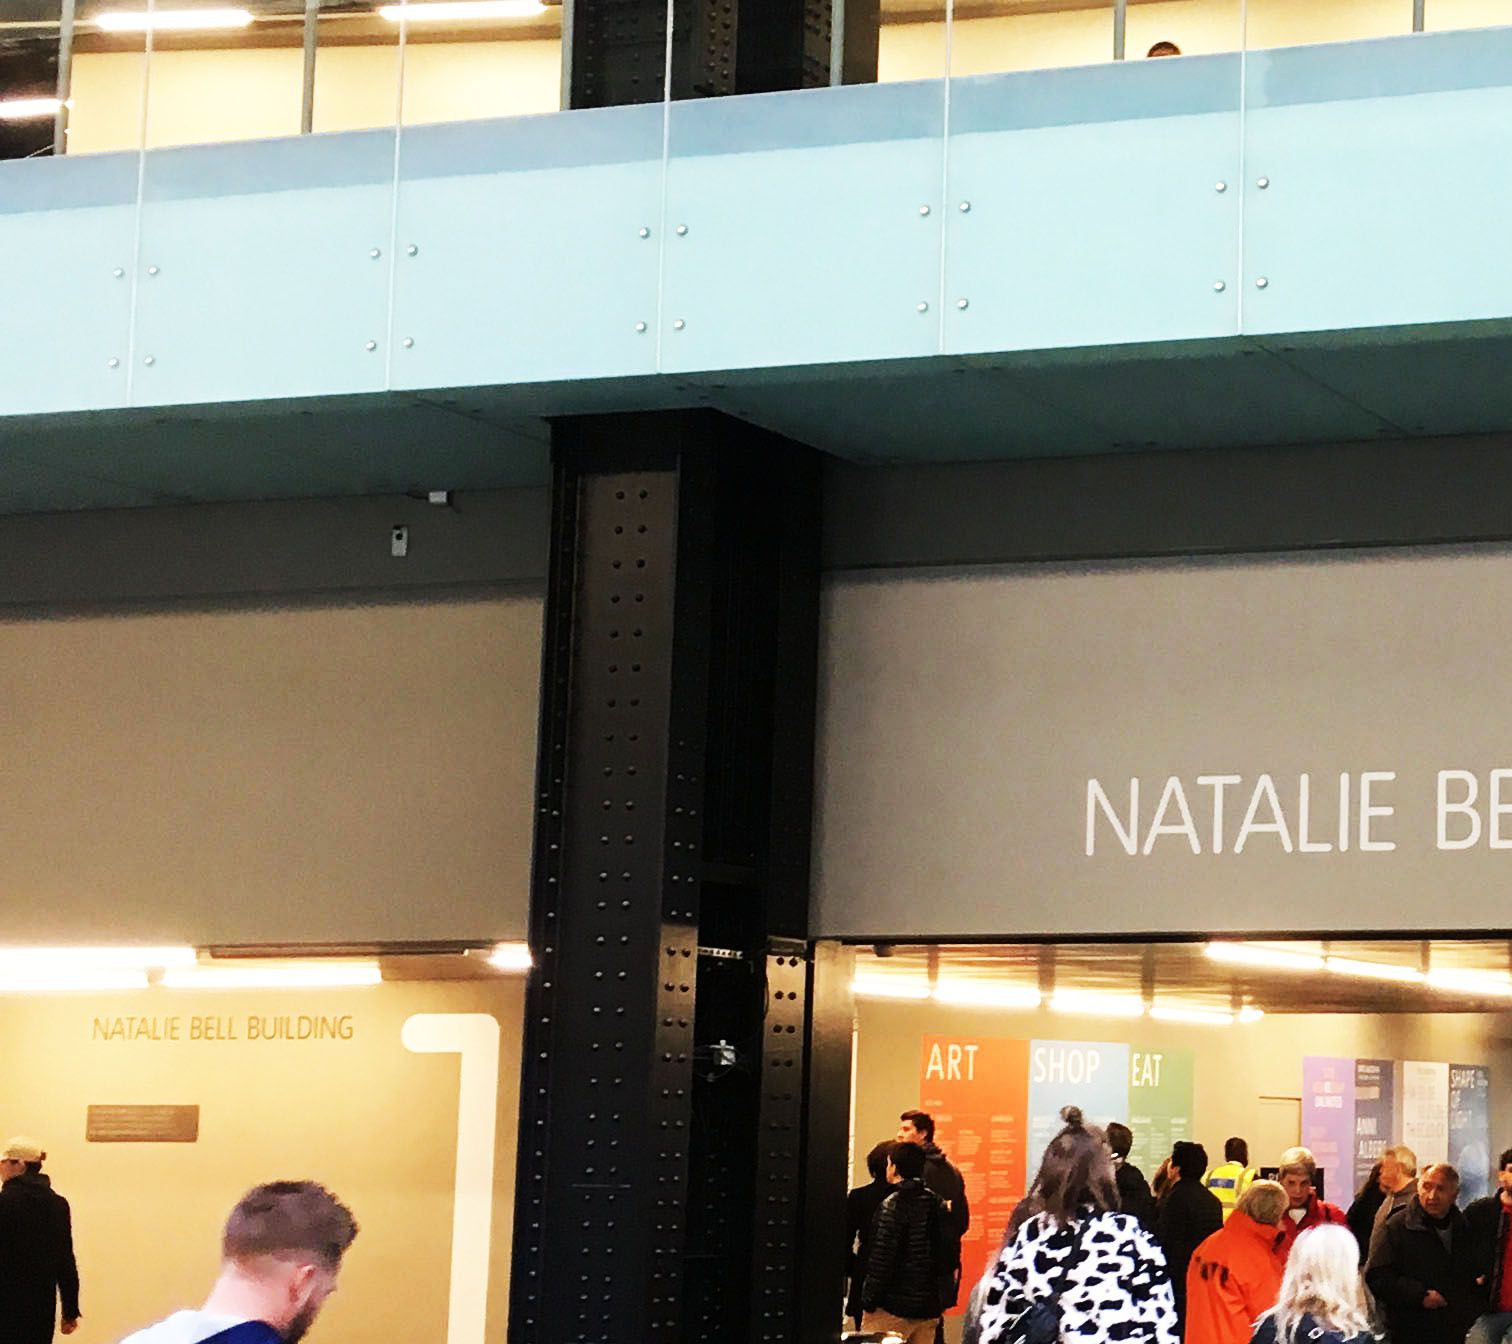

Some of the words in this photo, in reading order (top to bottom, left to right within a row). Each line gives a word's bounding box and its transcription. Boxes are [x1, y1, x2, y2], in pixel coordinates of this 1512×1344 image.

[1085, 771, 1397, 857] NATALIE
[92, 1016, 181, 1041] NATALIE
[189, 1015, 238, 1041] BELL
[247, 1015, 354, 1041] BUILDING
[925, 1043, 979, 1081] ART
[1034, 1047, 1101, 1084] SHOP
[1132, 1053, 1163, 1087] EAT
